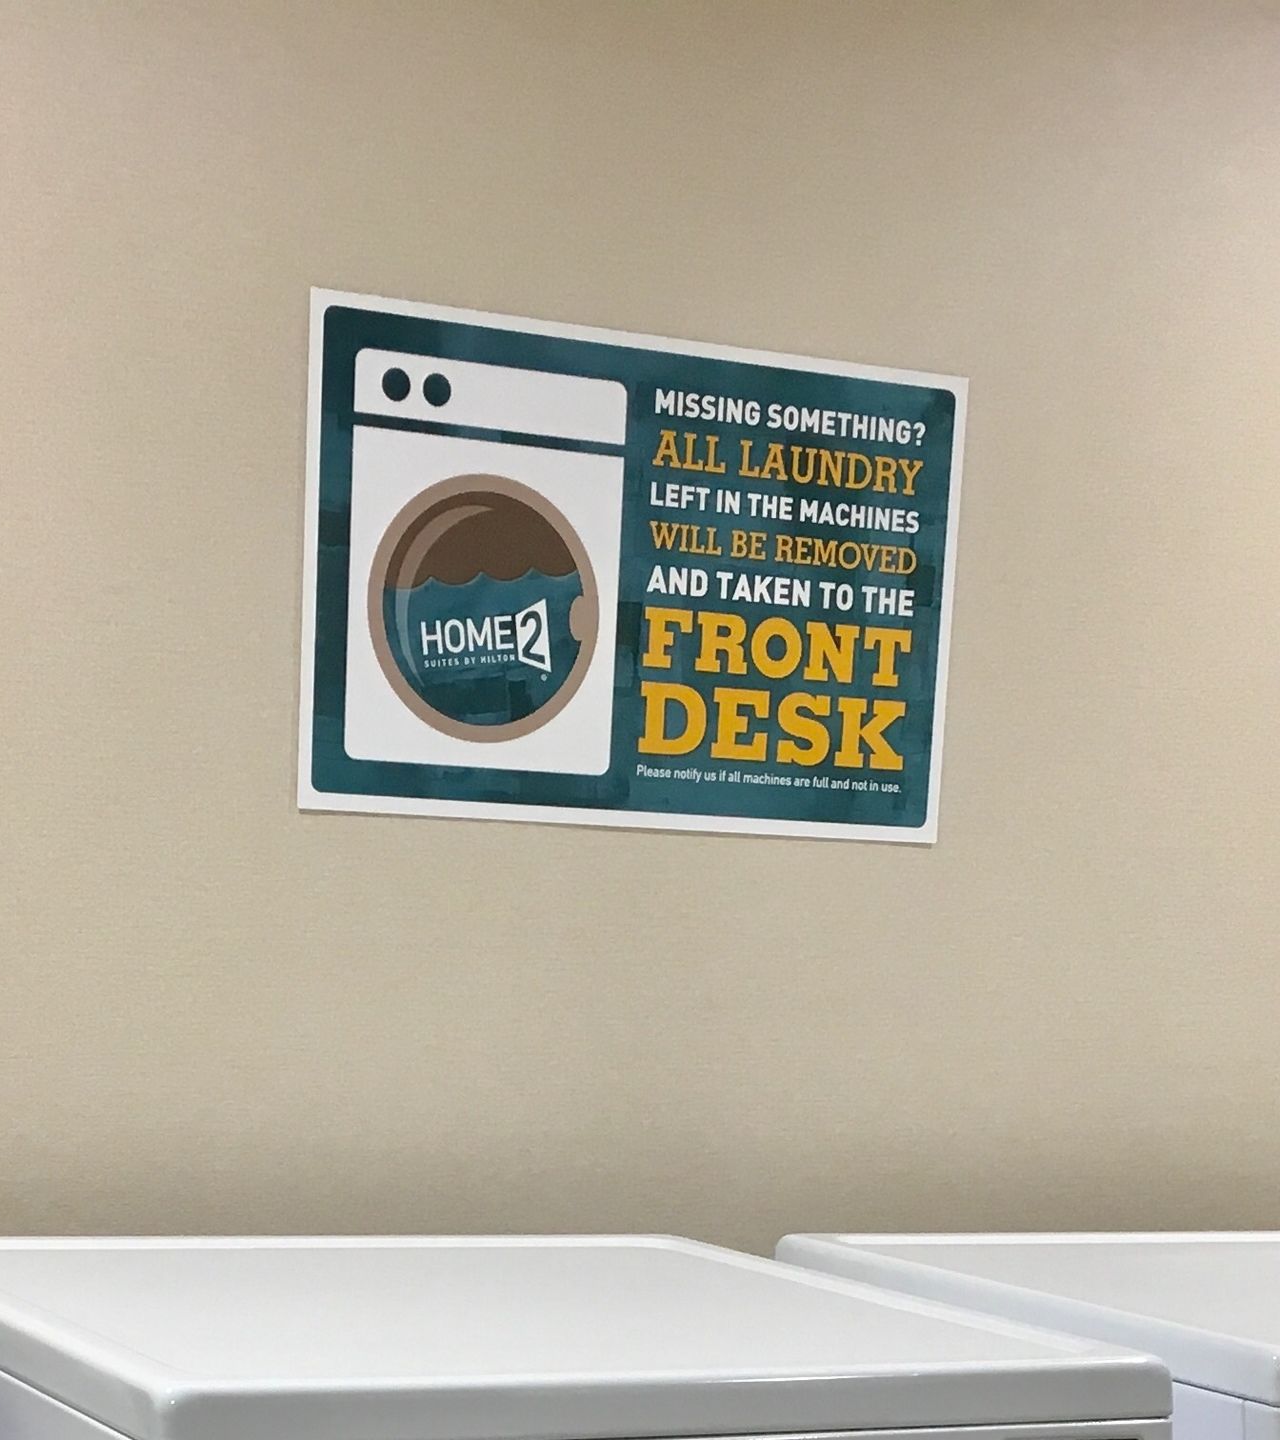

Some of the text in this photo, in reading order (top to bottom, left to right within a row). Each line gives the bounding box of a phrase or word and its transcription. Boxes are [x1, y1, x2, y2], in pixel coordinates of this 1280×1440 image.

[655, 389, 926, 446] MISSING SOMETHING?
[652, 430, 923, 495] ALL LAUNDRY
[651, 482, 919, 533] LEFT IN THE MACHINES
[650, 521, 916, 575] WILL BE REMOVED
[647, 565, 915, 616] AND TAKEN TO THE
[424, 654, 515, 668] SUITES BY HILTON
[643, 606, 912, 687] FRONT
[638, 681, 906, 770] DESK
[636, 765, 901, 793] Please notify us if all machines are full and not in use.
